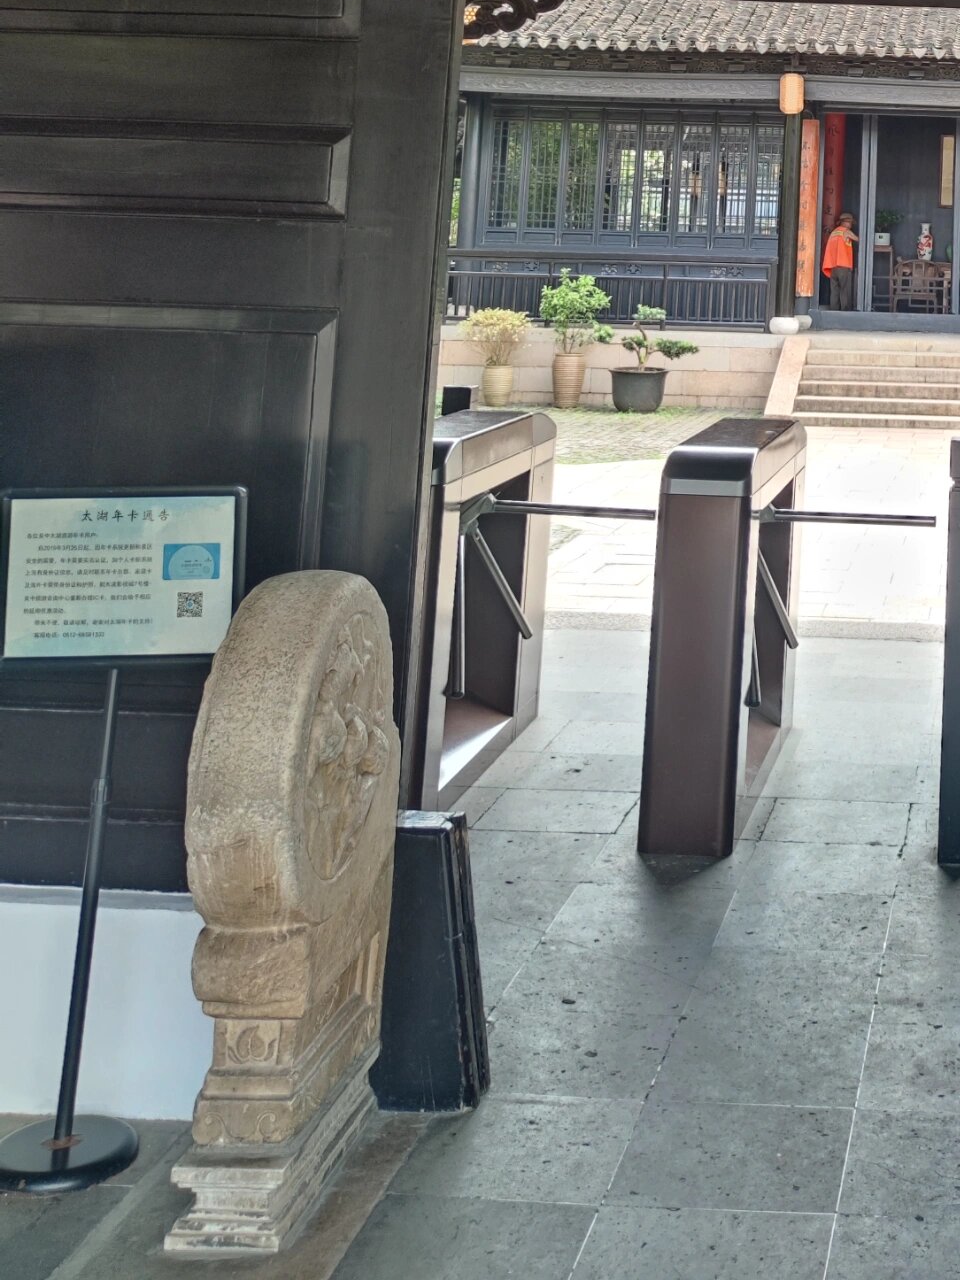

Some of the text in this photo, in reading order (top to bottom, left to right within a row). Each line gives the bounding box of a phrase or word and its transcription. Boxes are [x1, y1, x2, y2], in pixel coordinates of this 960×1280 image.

[81, 508, 170, 522] 太湖年卡通告
